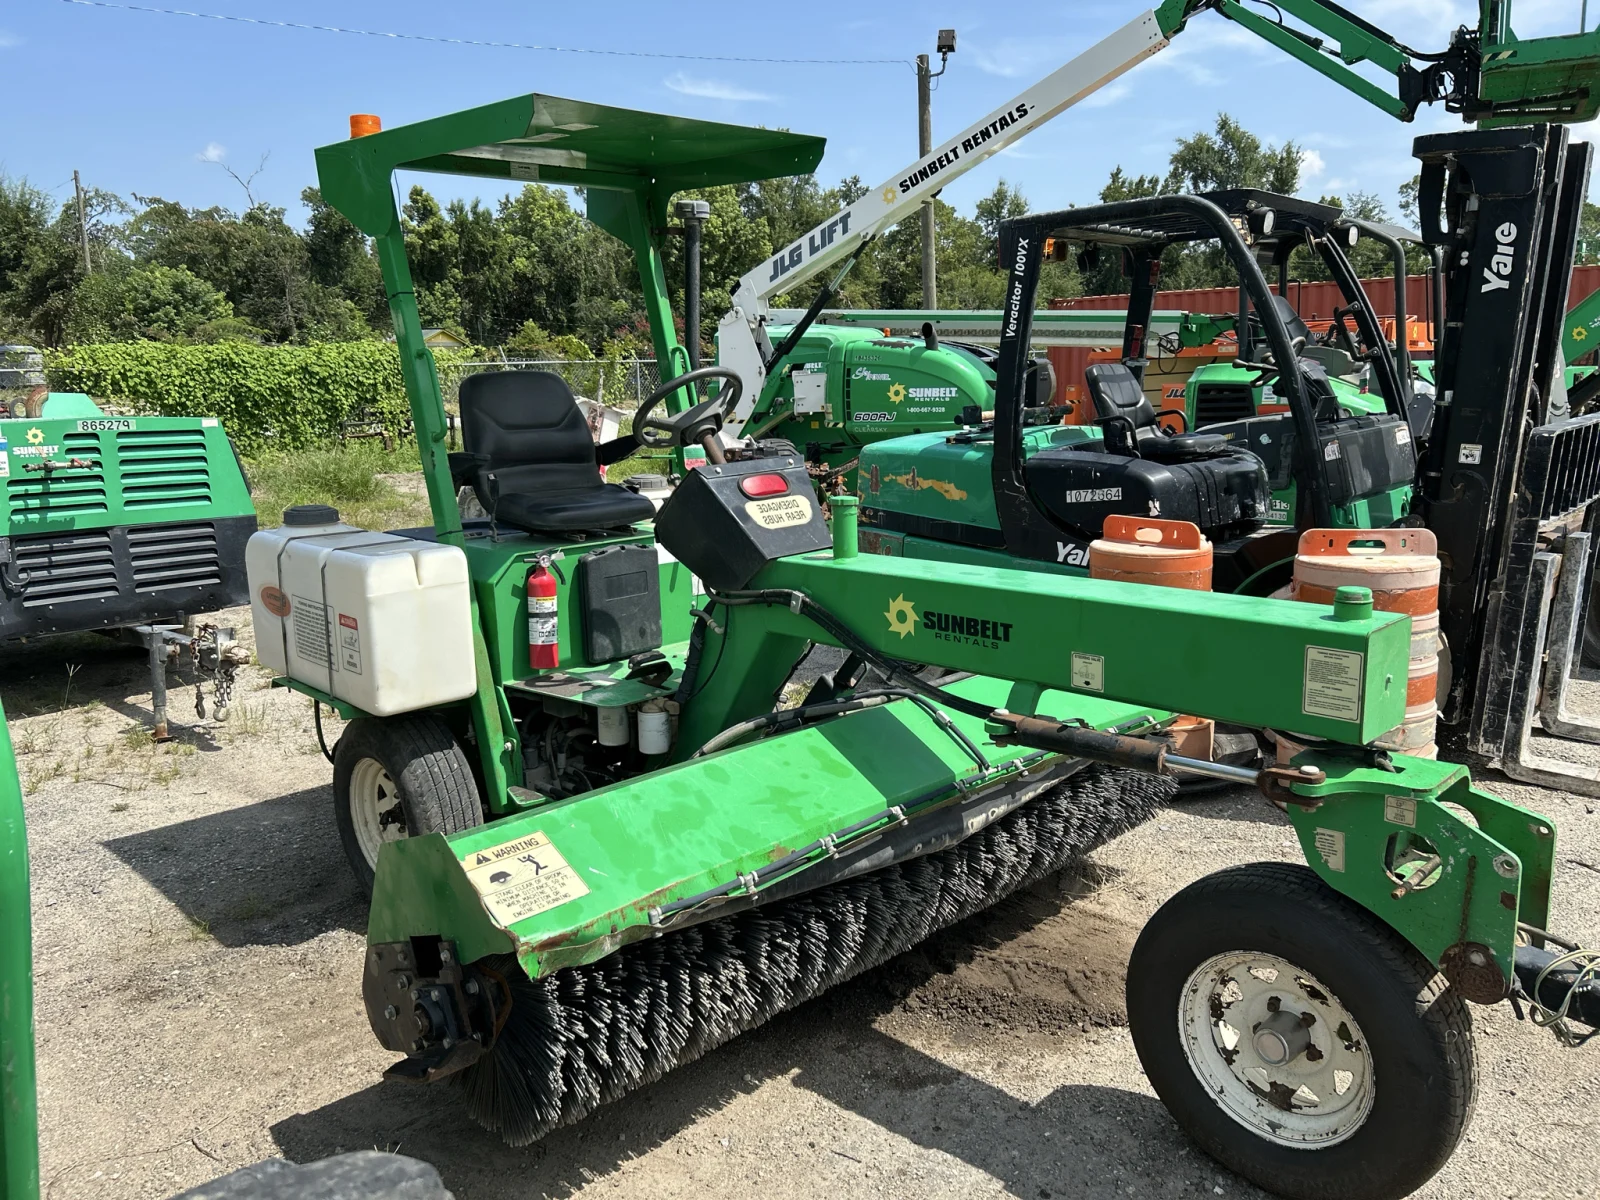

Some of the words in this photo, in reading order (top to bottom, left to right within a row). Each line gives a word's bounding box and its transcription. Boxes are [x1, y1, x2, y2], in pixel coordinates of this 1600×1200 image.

[899, 146, 960, 193] SUNBELT
[961, 103, 1029, 154] RENTALS
[770, 243, 802, 283] JLG
[808, 212, 851, 256] LIFT
[1481, 222, 1518, 293] Yale
[1005, 281, 1023, 337] Veracitor
[1014, 237, 1029, 276] 100VX
[909, 387, 957, 397] SUNBELT
[81, 420, 130, 431] 865279
[1056, 541, 1090, 566] Yal
[923, 610, 1013, 642] SUNBELT
[935, 632, 999, 649] RENTALS
[492, 838, 540, 859] WARNING
[495, 889, 514, 899] STAND
[515, 882, 534, 891] CLEAR
[495, 893, 521, 905] MINIMUM
[522, 882, 550, 896] DISTANCE
[505, 899, 521, 908] WHEN
[522, 890, 547, 901] MACHINE
[519, 895, 551, 909] OPERATION
[512, 907, 535, 918] ENGINE
[546, 892, 571, 905] RUNNING
